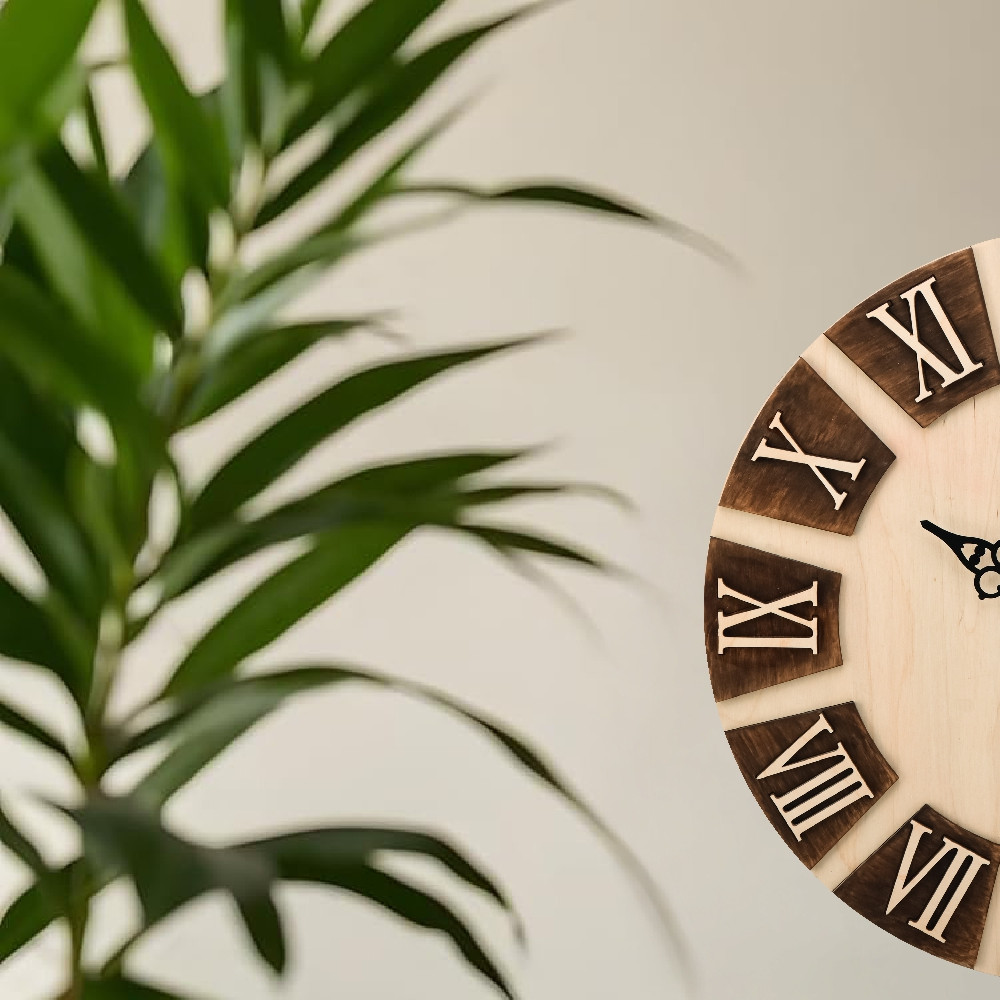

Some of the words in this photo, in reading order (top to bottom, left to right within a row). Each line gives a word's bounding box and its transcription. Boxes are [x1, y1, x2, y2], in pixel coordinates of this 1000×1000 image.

[866, 277, 984, 403] XI
[751, 412, 867, 511] X
[718, 578, 818, 655] IX
[756, 713, 875, 842] VIII
[886, 820, 991, 944] VII
